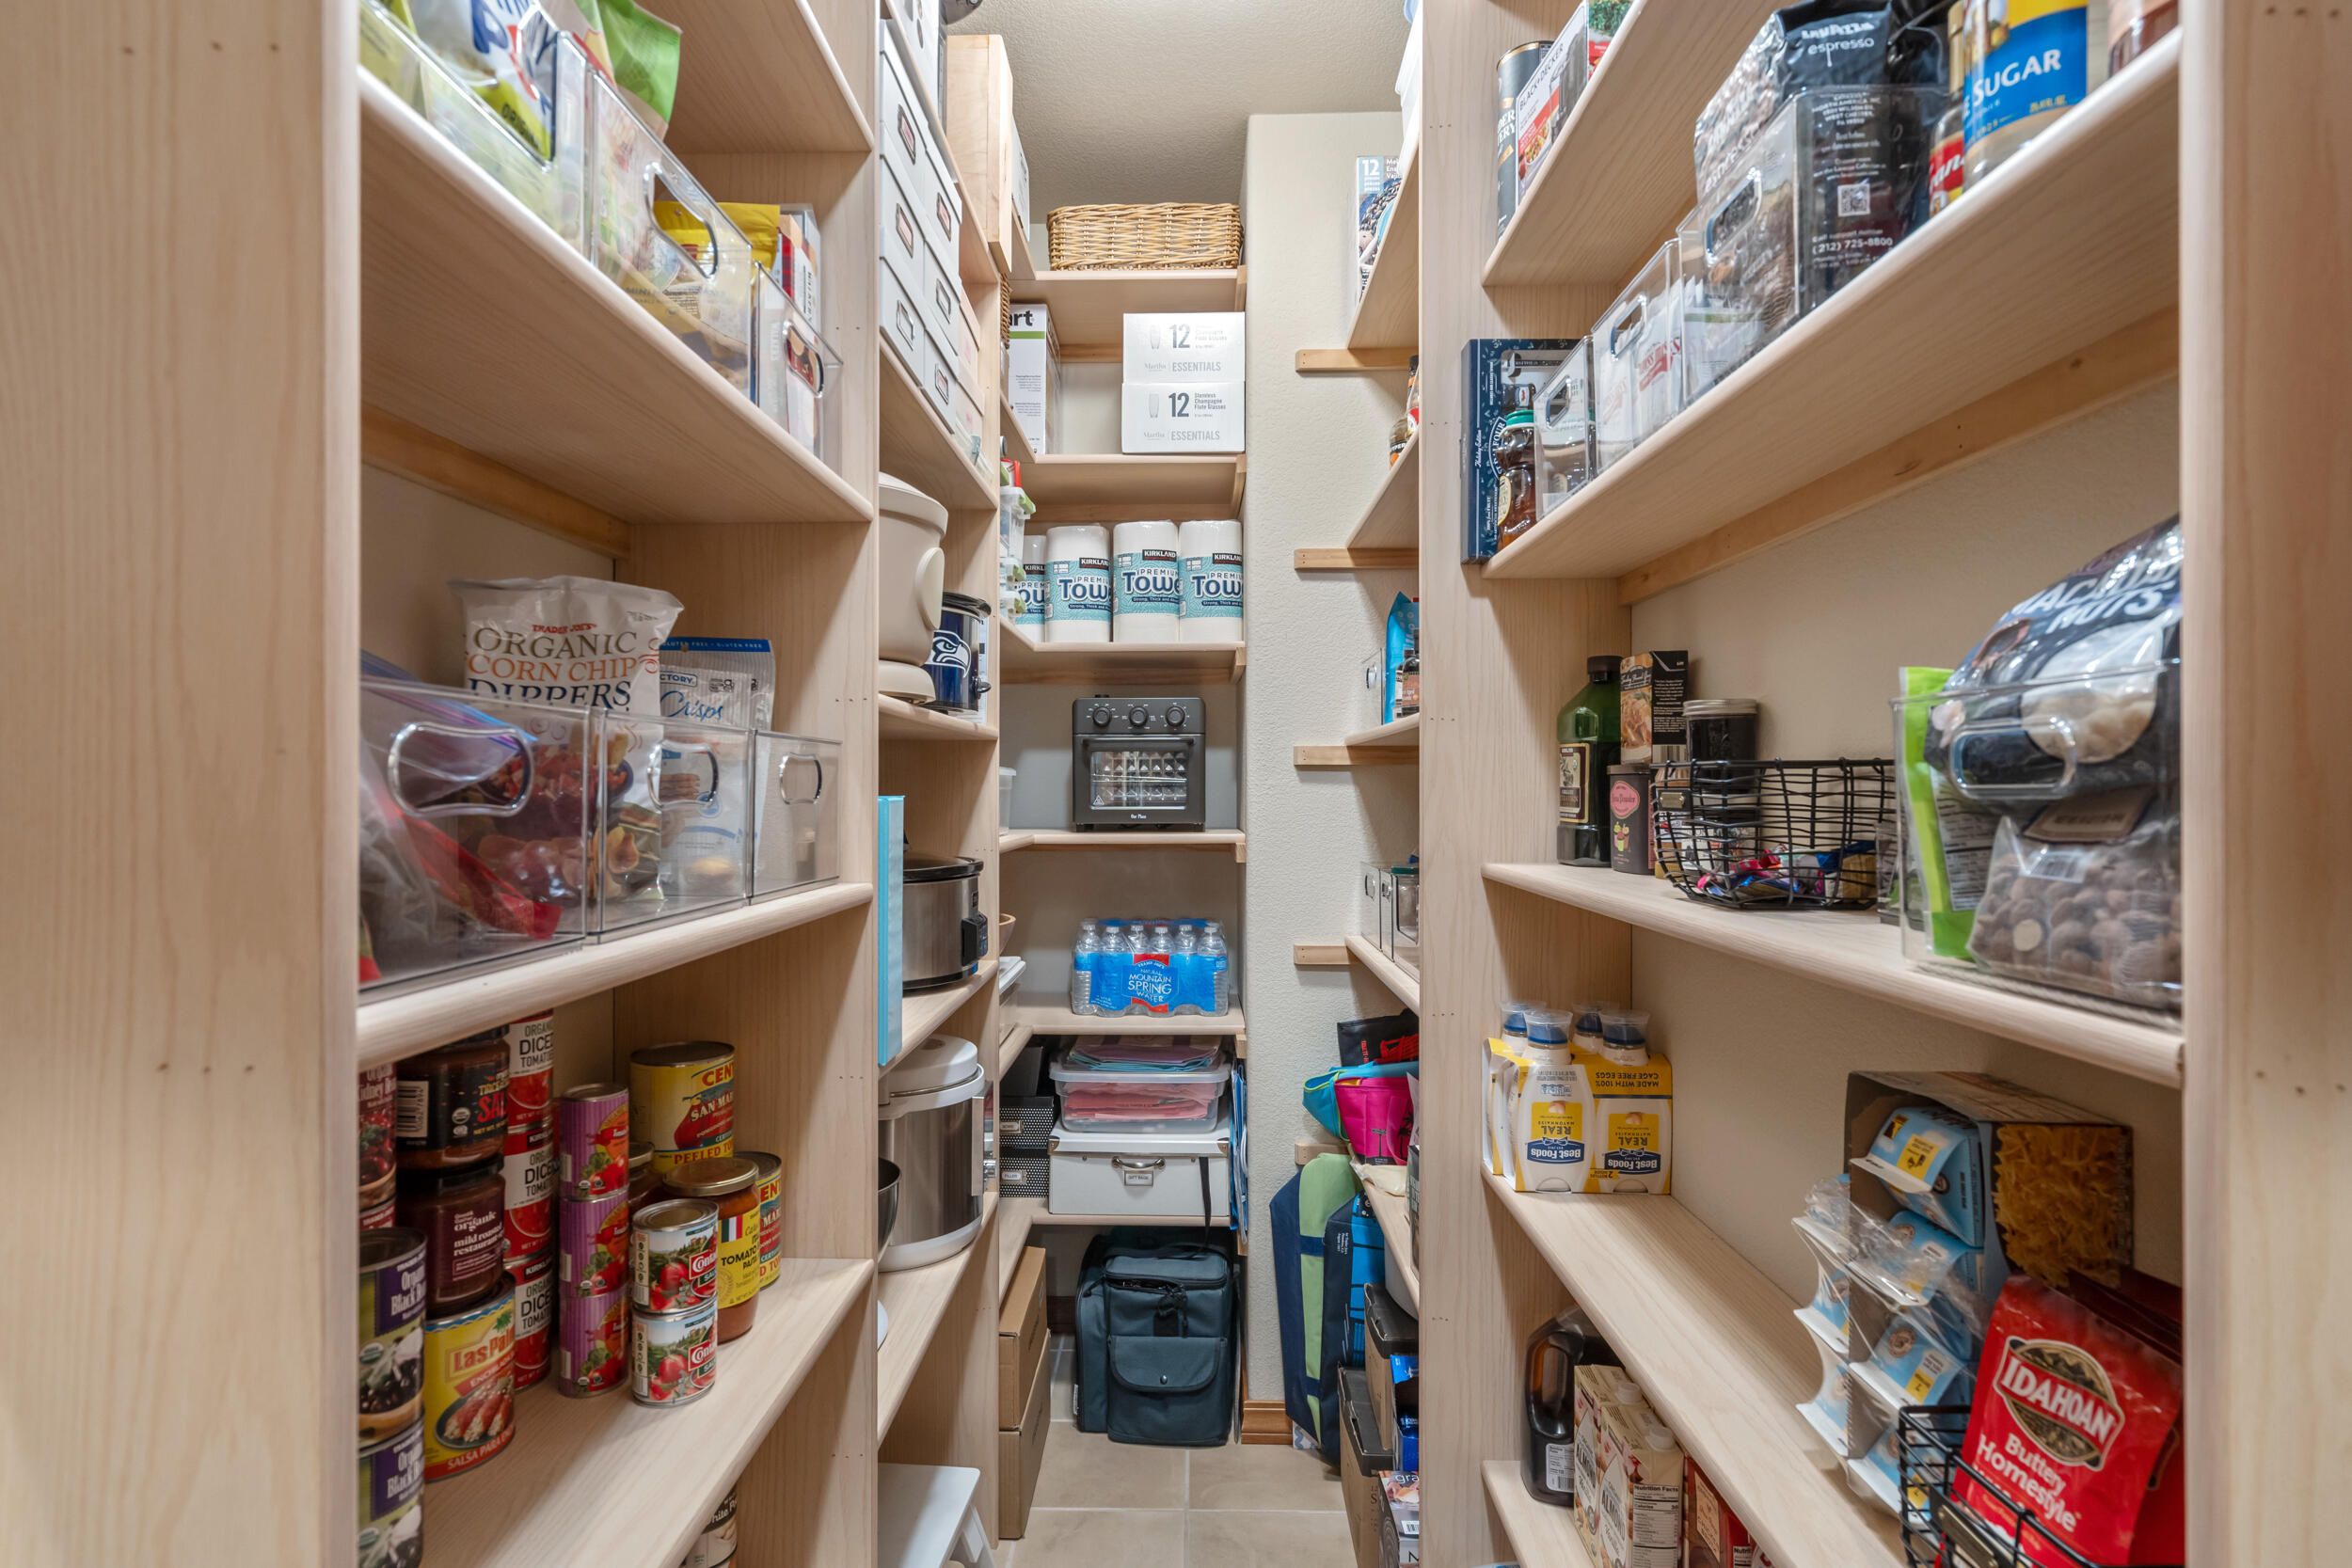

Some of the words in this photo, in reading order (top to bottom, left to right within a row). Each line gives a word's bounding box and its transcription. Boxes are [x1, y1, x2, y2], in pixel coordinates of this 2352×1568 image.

[1807, 38, 1875, 67] espresso
[1973, 49, 2061, 107] SUGAR
[1362, 159, 1379, 176] 12
[1813, 243, 1841, 255] (212)
[1844, 237, 1893, 249] 725-8800
[1169, 324, 1190, 348] 12
[1172, 361, 1221, 372] ESSENTIALS
[1168, 393, 1189, 418] 12
[1171, 431, 1220, 440] ESSENTIALS
[2045, 580, 2176, 635] NUTS
[474, 626, 638, 658] ORGANIC
[469, 654, 564, 681] CORN
[568, 657, 638, 682] CHIP
[469, 678, 632, 709] DIPPERS
[660, 690, 723, 722] Crisps
[1128, 980, 1172, 995] SPRING
[1129, 974, 1172, 983] MOUNTAIN
[1136, 991, 1164, 1003] WATER
[691, 1102, 715, 1121] SAN
[1543, 1126, 1571, 1135] REAL
[1618, 1136, 1648, 1146] REAL
[674, 1145, 722, 1164] PEELED
[1531, 1148, 1558, 1159] Foods
[1559, 1148, 1581, 1159] Best
[1608, 1159, 1634, 1170] Foods
[1636, 1159, 1658, 1170] Best
[453, 1233, 477, 1248] mild
[722, 1246, 756, 1266] TOMATO
[453, 1343, 487, 1373] Las
[2000, 1355, 2117, 1446] IDAHOAN
[448, 1450, 479, 1469] SALSA
[480, 1438, 501, 1459] PARA
[1577, 1442, 1596, 1489] ALMOND
[2004, 1433, 2067, 1496] Buttery
[1977, 1433, 2077, 1532] Homestyle
[1601, 1490, 1626, 1541] ALMOND
